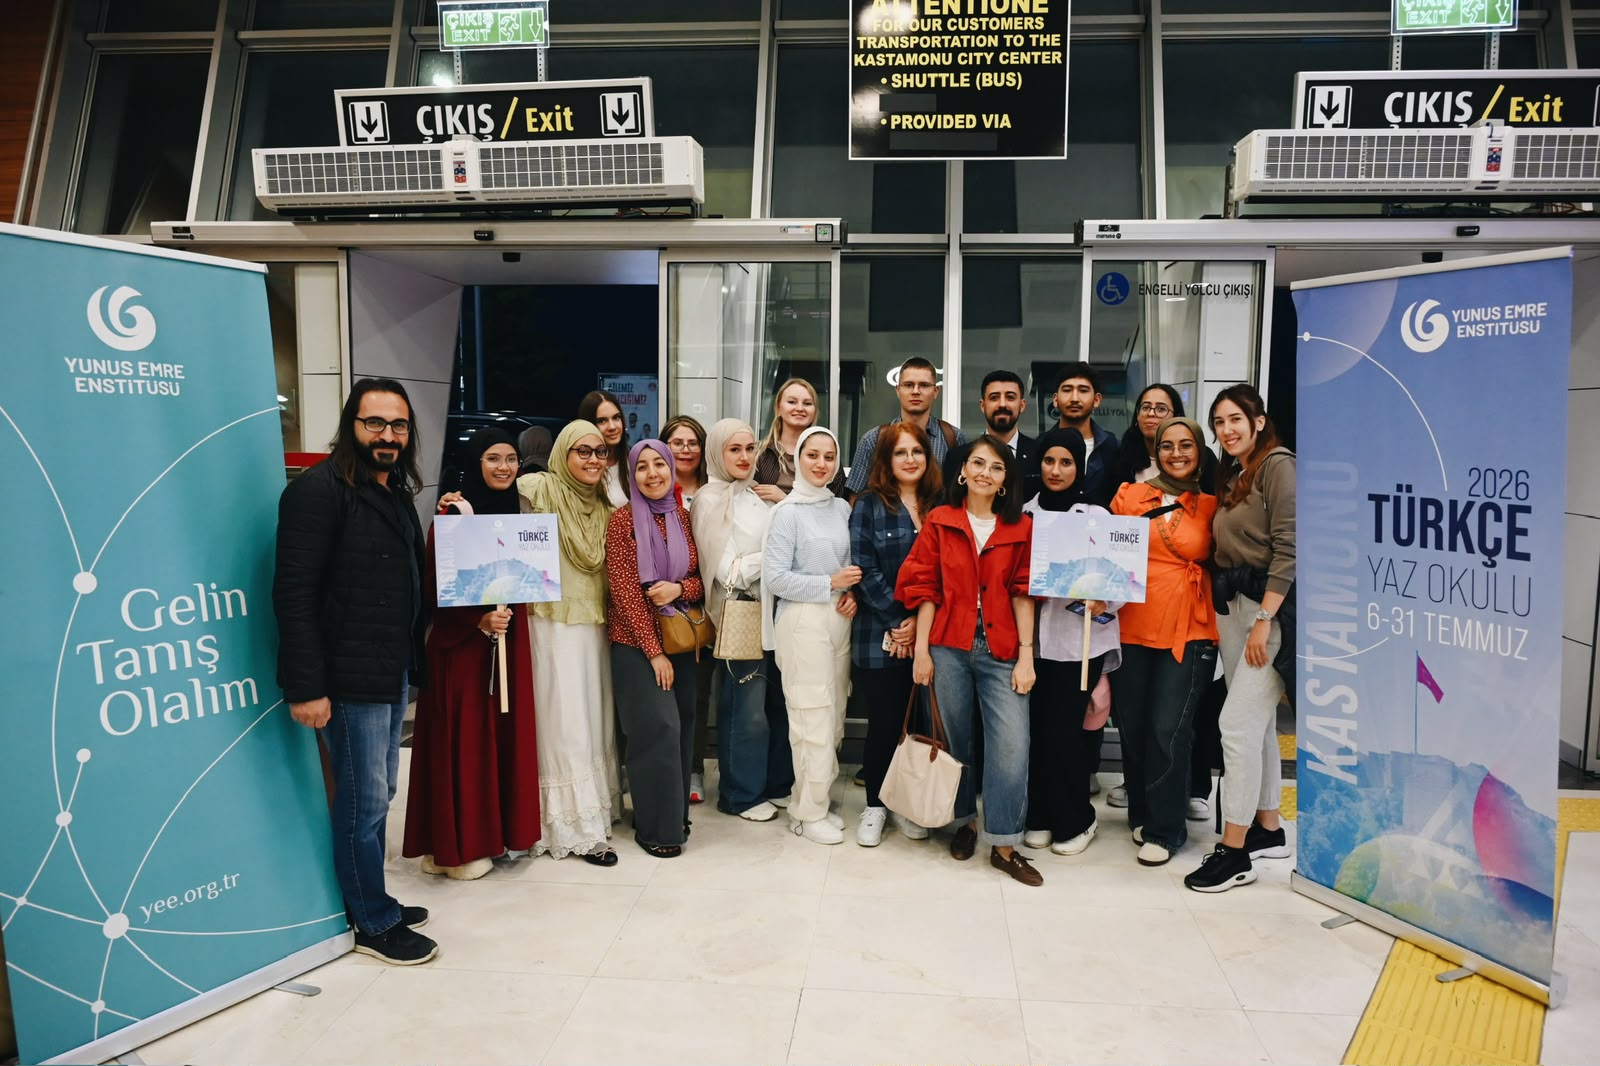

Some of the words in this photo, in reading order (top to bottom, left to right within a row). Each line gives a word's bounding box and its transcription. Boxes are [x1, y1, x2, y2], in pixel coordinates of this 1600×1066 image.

[447, 12, 494, 30] ÇIKIŞ
[873, 19, 904, 31] FOR
[909, 19, 942, 31] OUR
[947, 17, 1044, 31] CUSTOMERS
[1406, 10, 1451, 24] EXIT
[452, 28, 491, 42] EXIT
[857, 36, 998, 48] TRANSPORTATION
[1004, 35, 1024, 47] TO
[1029, 34, 1061, 46] THE
[854, 54, 952, 66] KASTAMONU
[957, 53, 994, 65] CITY
[999, 52, 1062, 64] CENTER
[891, 73, 970, 88] SHUTTLE
[975, 72, 1023, 90] (BUS)
[1384, 91, 1473, 129] ÇIKIŞ
[1509, 94, 1564, 122] Exit
[416, 103, 495, 144] ÇIKIŞ
[525, 104, 574, 132] Exit
[891, 115, 977, 129] PROVIDED
[982, 114, 1012, 129] VIA
[1138, 281, 1182, 296] ENGELLİ
[1184, 284, 1220, 296] YOLCU
[1224, 284, 1254, 299] ÇIKIŞI
[1452, 306, 1501, 323] YUNUS
[1505, 302, 1548, 319] EMRE
[64, 357, 133, 376] YUNUS
[138, 361, 185, 379] EMRE
[1468, 467, 1529, 501] 2026
[1368, 483, 1532, 568] TÜRKÇE
[518, 530, 549, 543] TÜRKÇE
[1110, 531, 1140, 544] TÜRKÇE
[1367, 555, 1417, 600] YAZ
[1428, 563, 1531, 618] OKULU
[121, 582, 248, 632] Gelin
[1304, 461, 1358, 785] KASTAMONU
[1367, 602, 1414, 639] 6-31
[1424, 611, 1529, 661] TEMMUZ
[76, 634, 220, 684] Tanış
[100, 677, 259, 736] Olalım
[139, 873, 240, 924] yee.org.tr
